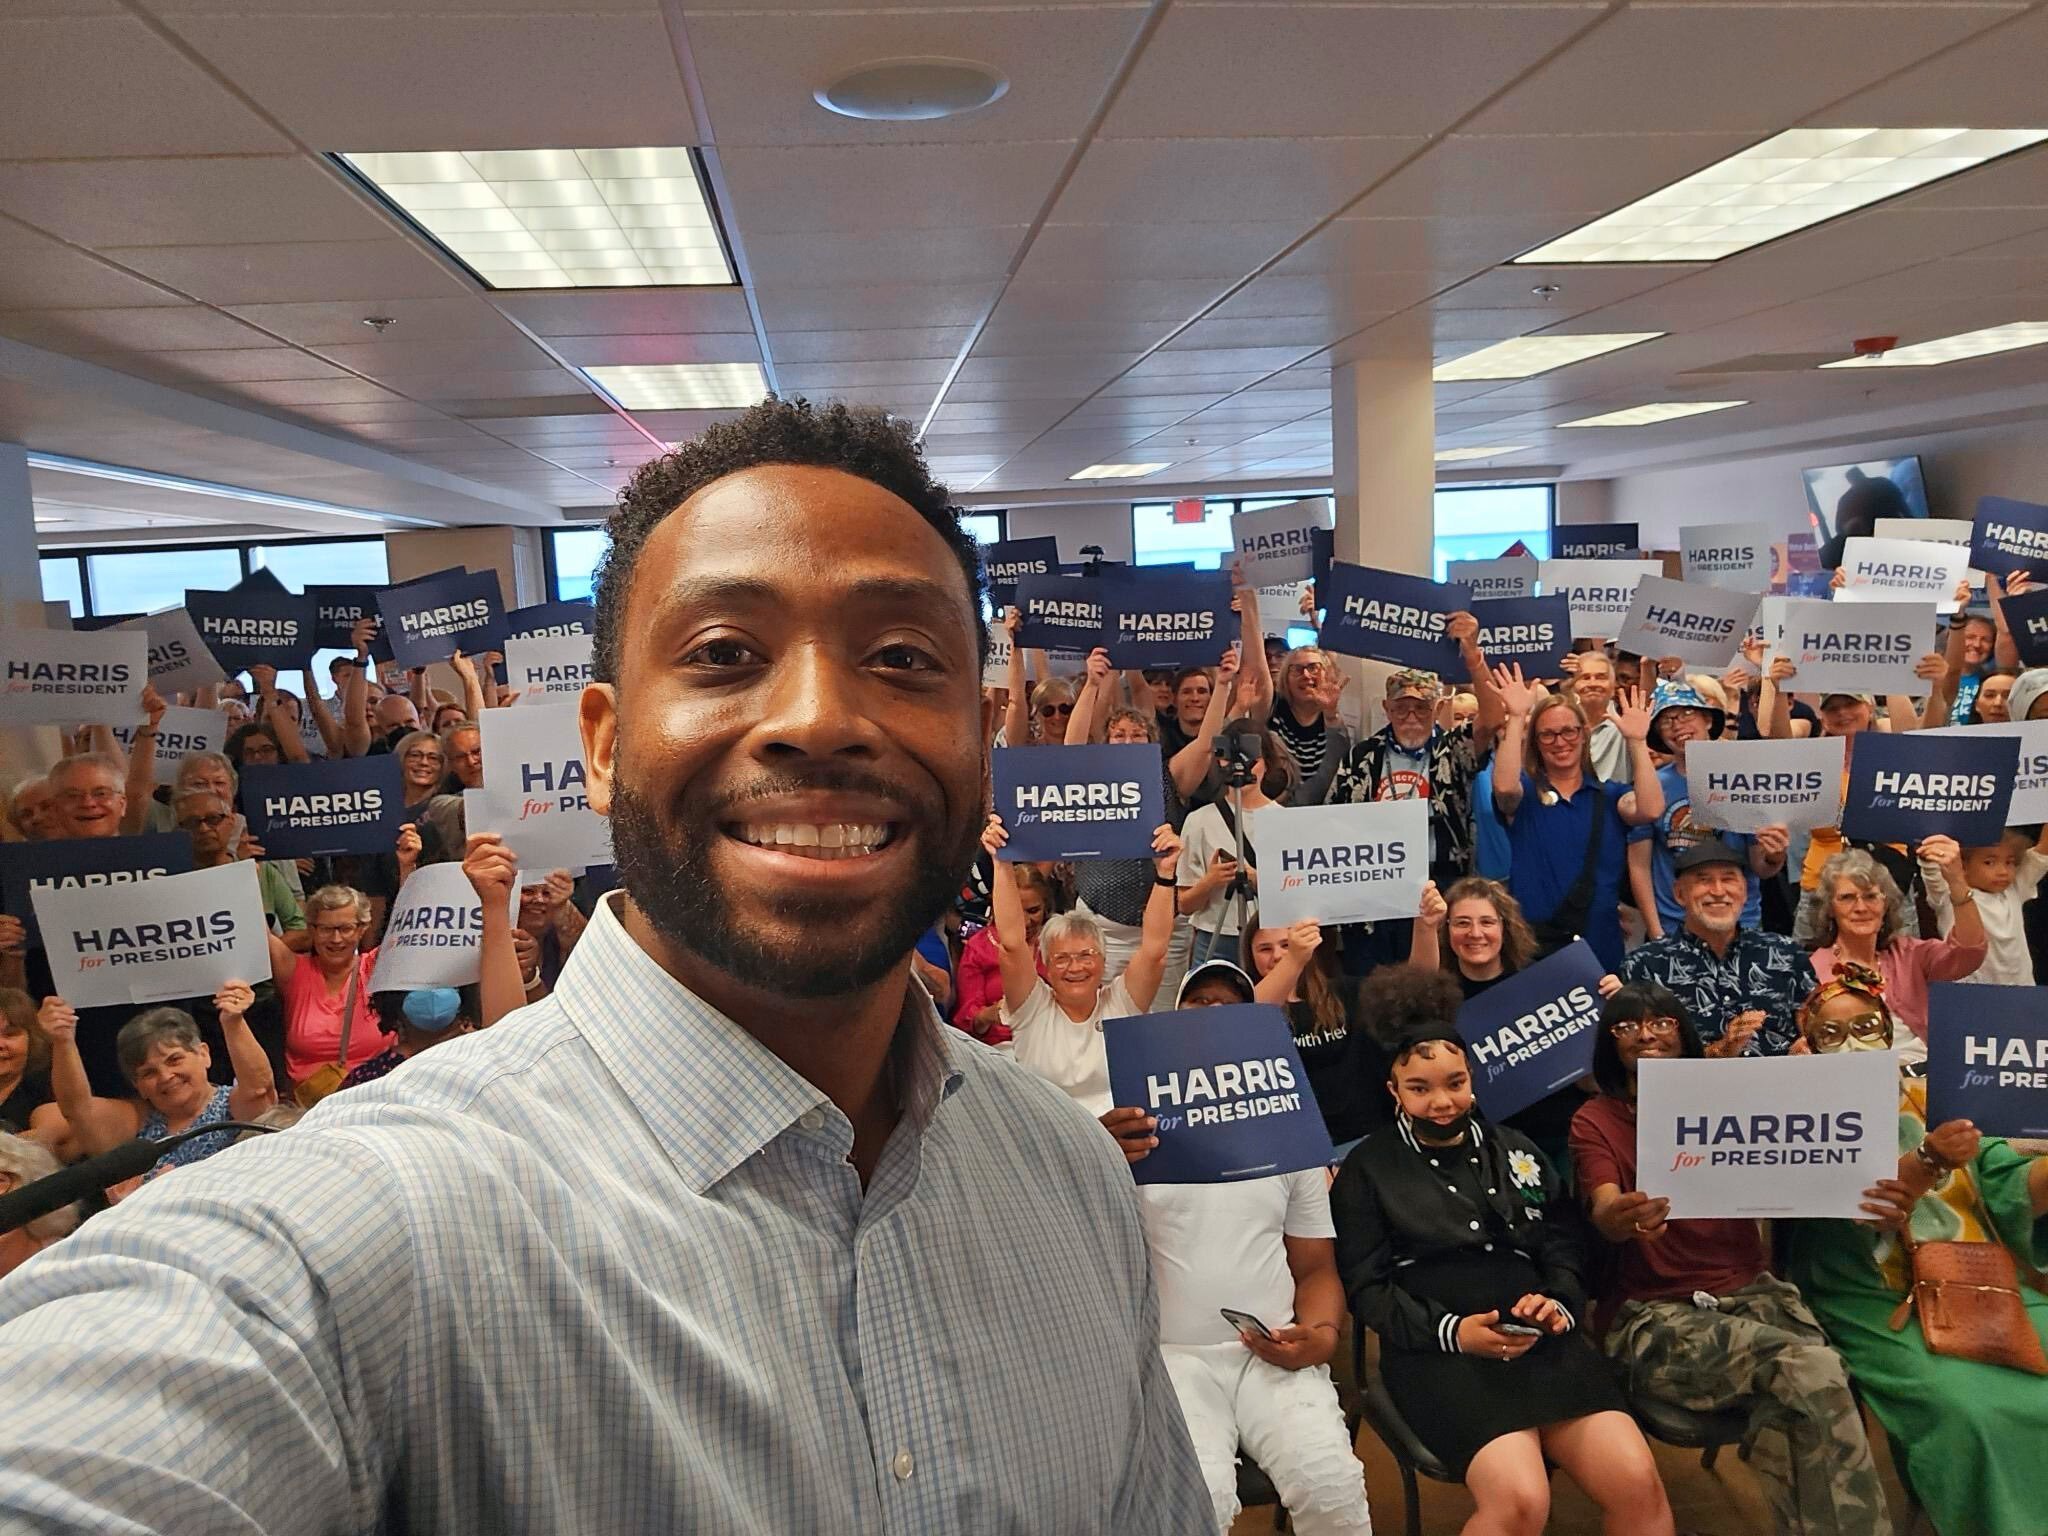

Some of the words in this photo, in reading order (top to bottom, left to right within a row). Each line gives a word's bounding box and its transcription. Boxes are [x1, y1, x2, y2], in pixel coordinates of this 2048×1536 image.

[1985, 522, 2048, 549] HARR
[1688, 547, 1754, 563] HARRIS
[985, 560, 1048, 577] HARRIS
[1857, 561, 1948, 580] HARRIS
[1871, 578, 1945, 590] PRESIDENT
[319, 606, 362, 619] HAR
[400, 599, 489, 631] HARRIS
[1044, 616, 1102, 629] PRESIDEN
[1119, 611, 1214, 630] HARRIS
[1345, 595, 1446, 631] HARRIS
[1646, 605, 1735, 634] HARRIS
[203, 617, 298, 635] HARRIS
[422, 616, 490, 639] PRESIDENT
[1116, 633, 1135, 644] for
[1136, 629, 1212, 641] PRESIDENT
[1361, 619, 1443, 643] PRESIDENT
[1477, 623, 1554, 644] ARRIS
[1660, 626, 1728, 644] PRESIDENT
[222, 636, 297, 646] PRESIDENT
[1803, 633, 1912, 651] HARRIS
[1800, 652, 1819, 664] for
[1822, 653, 1911, 664] PRESIDENT
[8, 661, 129, 682] HARRIS
[526, 664, 592, 683] HARR
[31, 684, 128, 694] PRESIDENT
[1708, 771, 1822, 792] HARRIS
[1875, 771, 1995, 797] HARRIS
[265, 789, 383, 816] HARRIS
[1016, 781, 1141, 808] HARRIS
[1730, 791, 1821, 804] PRESIDENT
[1868, 796, 1896, 810] for
[1898, 796, 1992, 812] PRESIDENT
[519, 798, 554, 820] for
[1015, 810, 1039, 827] for
[1041, 807, 1140, 823] PRESIDENT
[266, 818, 287, 832] for
[290, 810, 382, 828] PRESIDENT
[1281, 841, 1406, 872] HARRIS
[1280, 875, 1304, 891] for
[1308, 867, 1405, 886] PRESIDENT
[73, 910, 235, 952] HARRIS
[78, 956, 105, 972] for
[110, 936, 236, 966] PRESIDENT
[1470, 985, 1594, 1065] HARRIS
[1486, 1060, 1507, 1082] for
[1506, 1007, 1601, 1067] PRESIDENT
[1146, 1057, 1296, 1108] HARRIS
[1959, 1070, 1995, 1090] for
[1153, 1112, 1182, 1134] for
[1187, 1093, 1301, 1128] PRESIDENT
[1676, 1111, 1864, 1146] HARRIS
[1670, 1151, 1706, 1172] for
[1712, 1147, 1862, 1166] PRESIDENT
